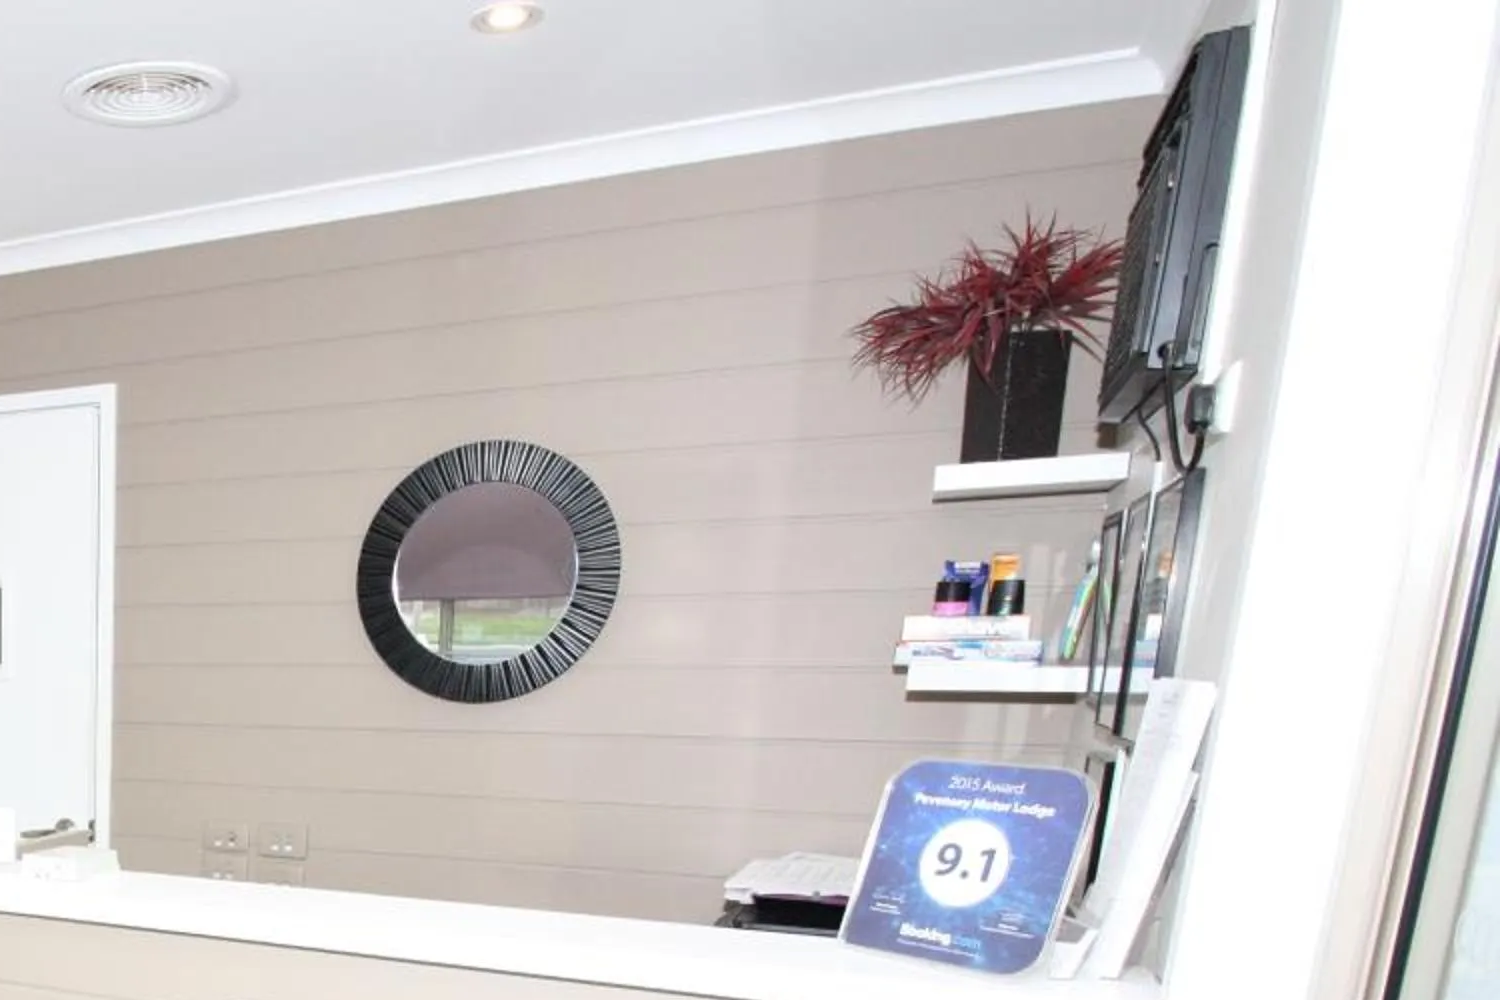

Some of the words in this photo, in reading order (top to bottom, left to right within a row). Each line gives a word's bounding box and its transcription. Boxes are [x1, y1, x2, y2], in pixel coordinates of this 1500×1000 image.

[948, 776, 980, 791] 2015
[981, 781, 1026, 795] Award
[971, 797, 1012, 813] Motor
[1011, 801, 1058, 819] Lodge
[934, 842, 997, 883] 9.1
